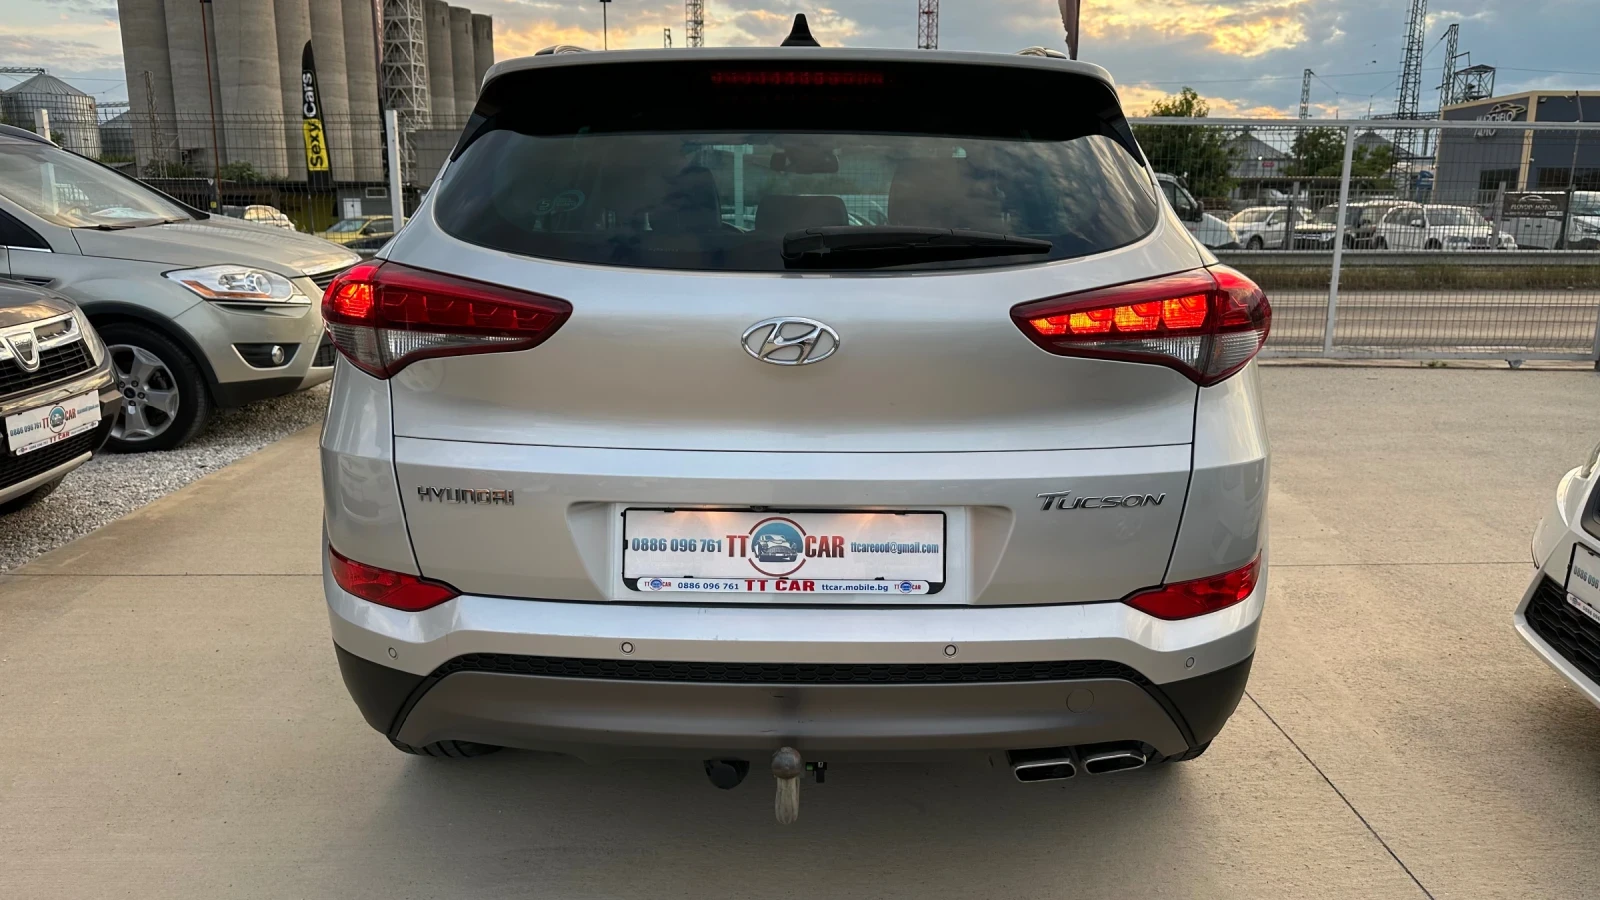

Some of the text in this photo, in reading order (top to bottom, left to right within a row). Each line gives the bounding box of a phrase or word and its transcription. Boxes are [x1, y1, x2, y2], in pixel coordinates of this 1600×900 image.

[302, 72, 323, 167] Sexy Cars
[42, 417, 50, 429] TT
[64, 408, 77, 421] CAR
[57, 431, 70, 441] CAR
[417, 485, 515, 506] HYUNDAI
[1036, 489, 1167, 511] TUCSON
[631, 535, 939, 558] 0886 096 761 TT CAR ttcareood@gmail.com
[677, 579, 889, 592] 0886 096 761 TT CAR ttcar.mobile.bg
[1573, 565, 1600, 589] 0886 096
